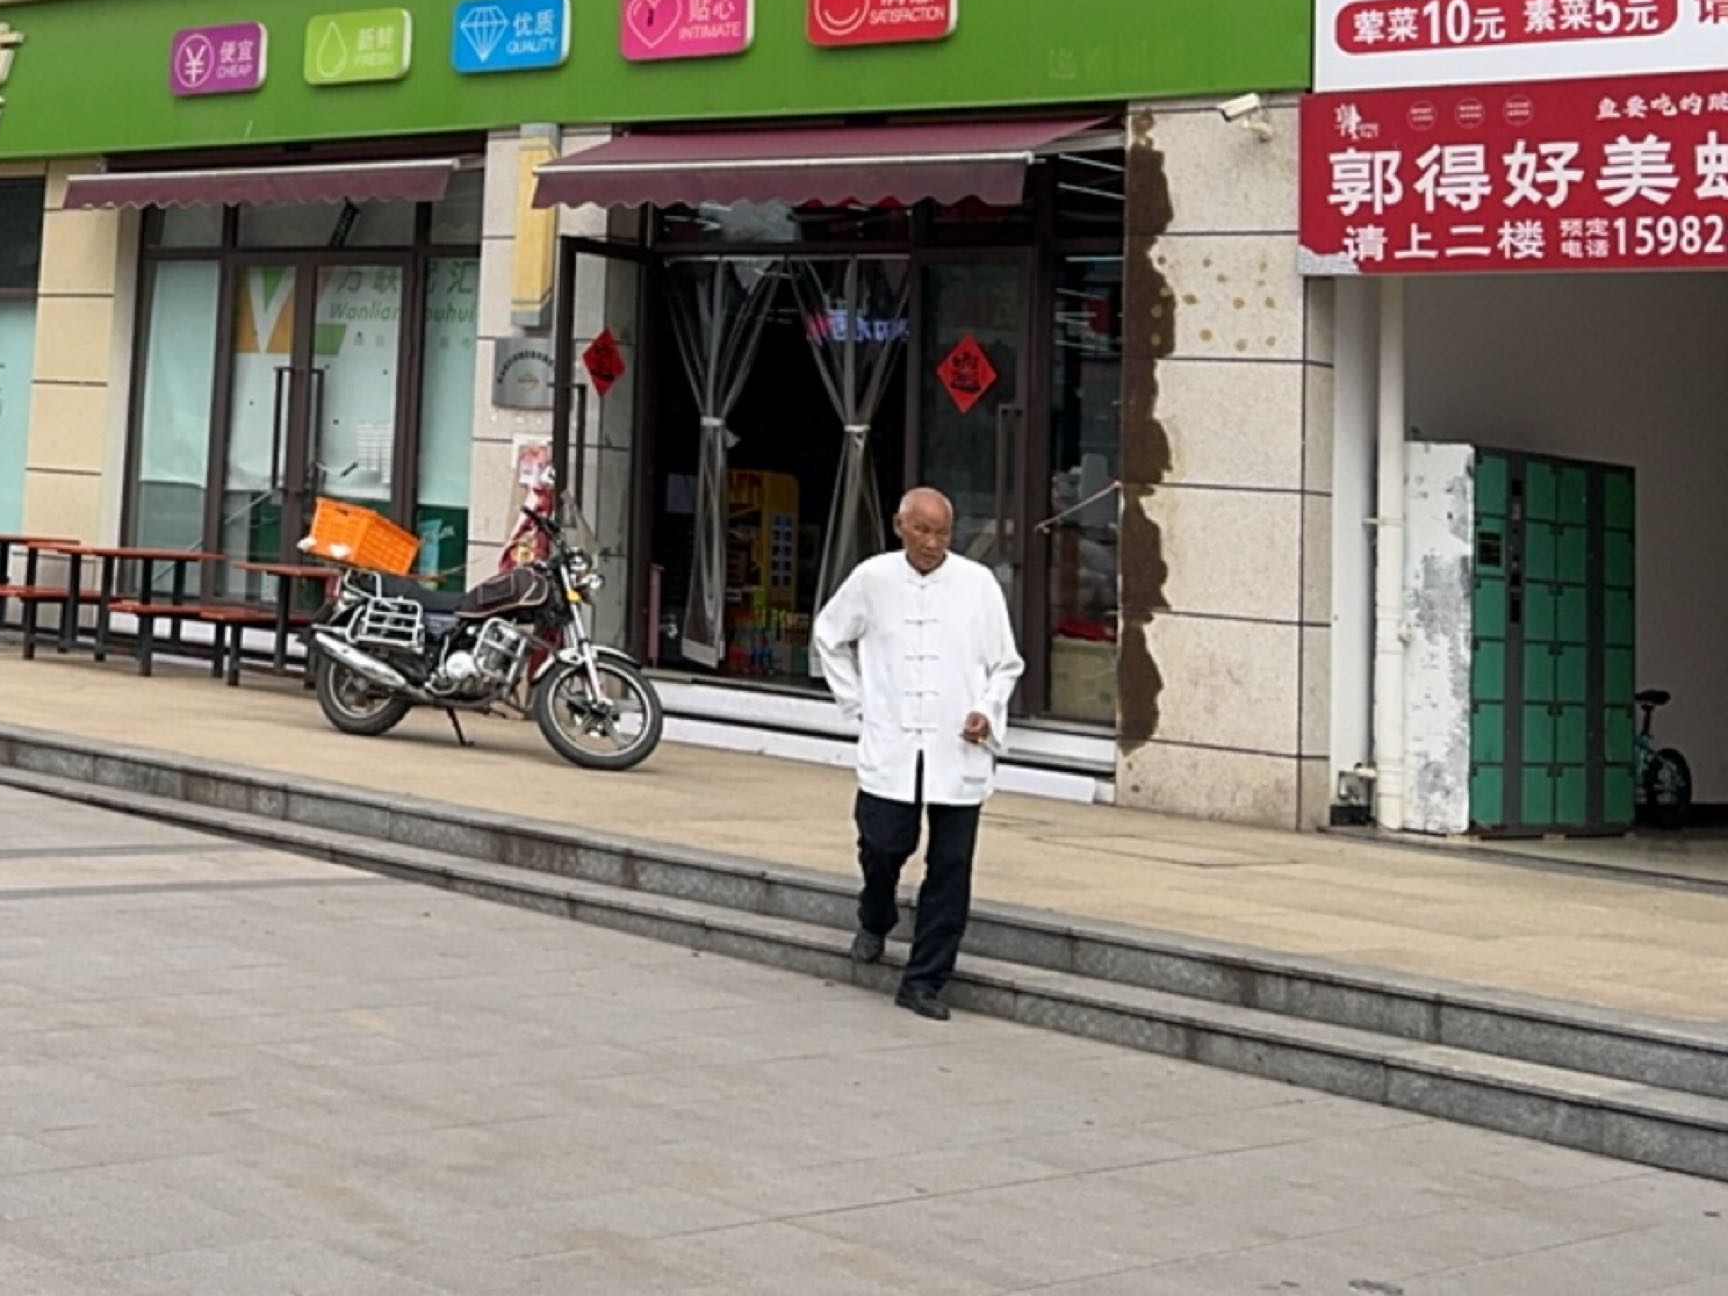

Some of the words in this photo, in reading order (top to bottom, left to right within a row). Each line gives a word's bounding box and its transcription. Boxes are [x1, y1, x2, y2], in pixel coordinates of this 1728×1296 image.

[512, 8, 554, 37] 优质
[870, 6, 946, 25] SATISFACTION
[679, 21, 741, 41] INTIMATE
[221, 40, 254, 63] 便宜
[505, 37, 557, 54] QUALITY
[1343, 218, 1547, 262] 请上二楼
[1613, 214, 1725, 256] 15982
